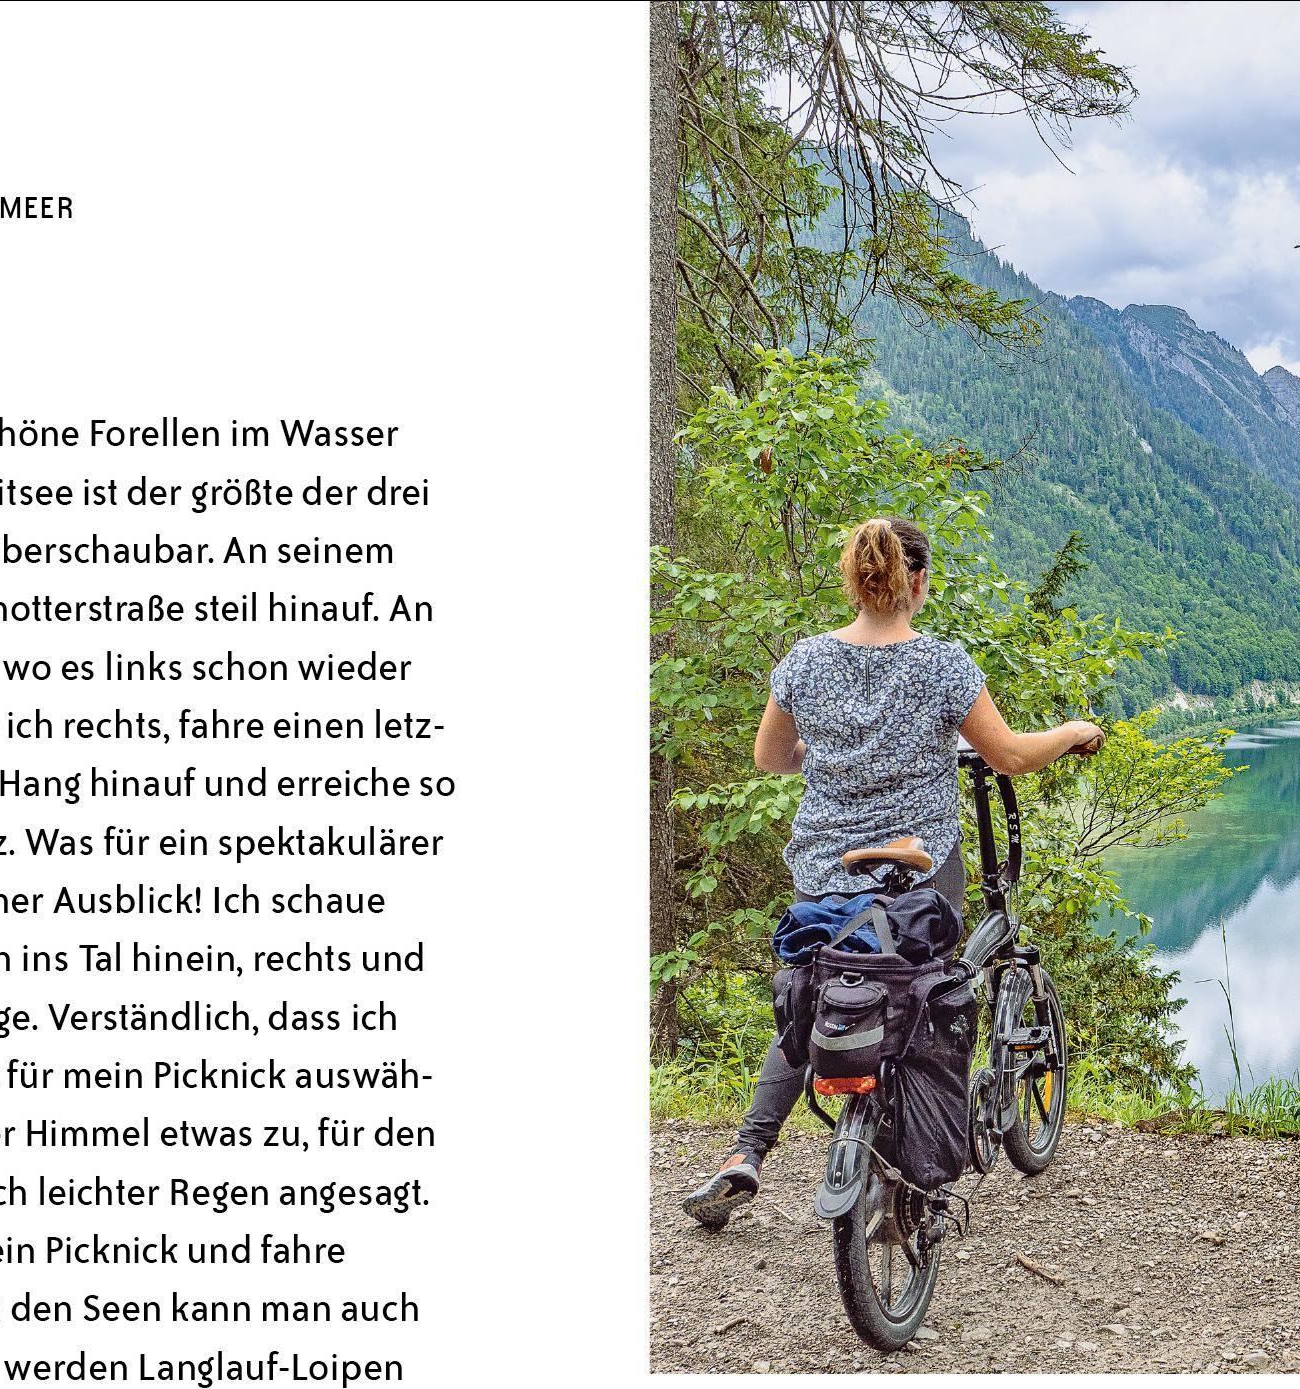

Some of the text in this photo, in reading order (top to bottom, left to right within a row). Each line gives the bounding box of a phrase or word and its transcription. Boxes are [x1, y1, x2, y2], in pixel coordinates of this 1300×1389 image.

[0, 196, 73, 219] MEER
[24, 828, 93, 856] Was
[103, 825, 150, 856] für
[159, 828, 208, 856] ein
[218, 825, 444, 864] spektakulärer
[39, 1175, 160, 1206] leichter
[171, 1178, 269, 1214] Regen
[279, 1179, 429, 1214] angesagt.
